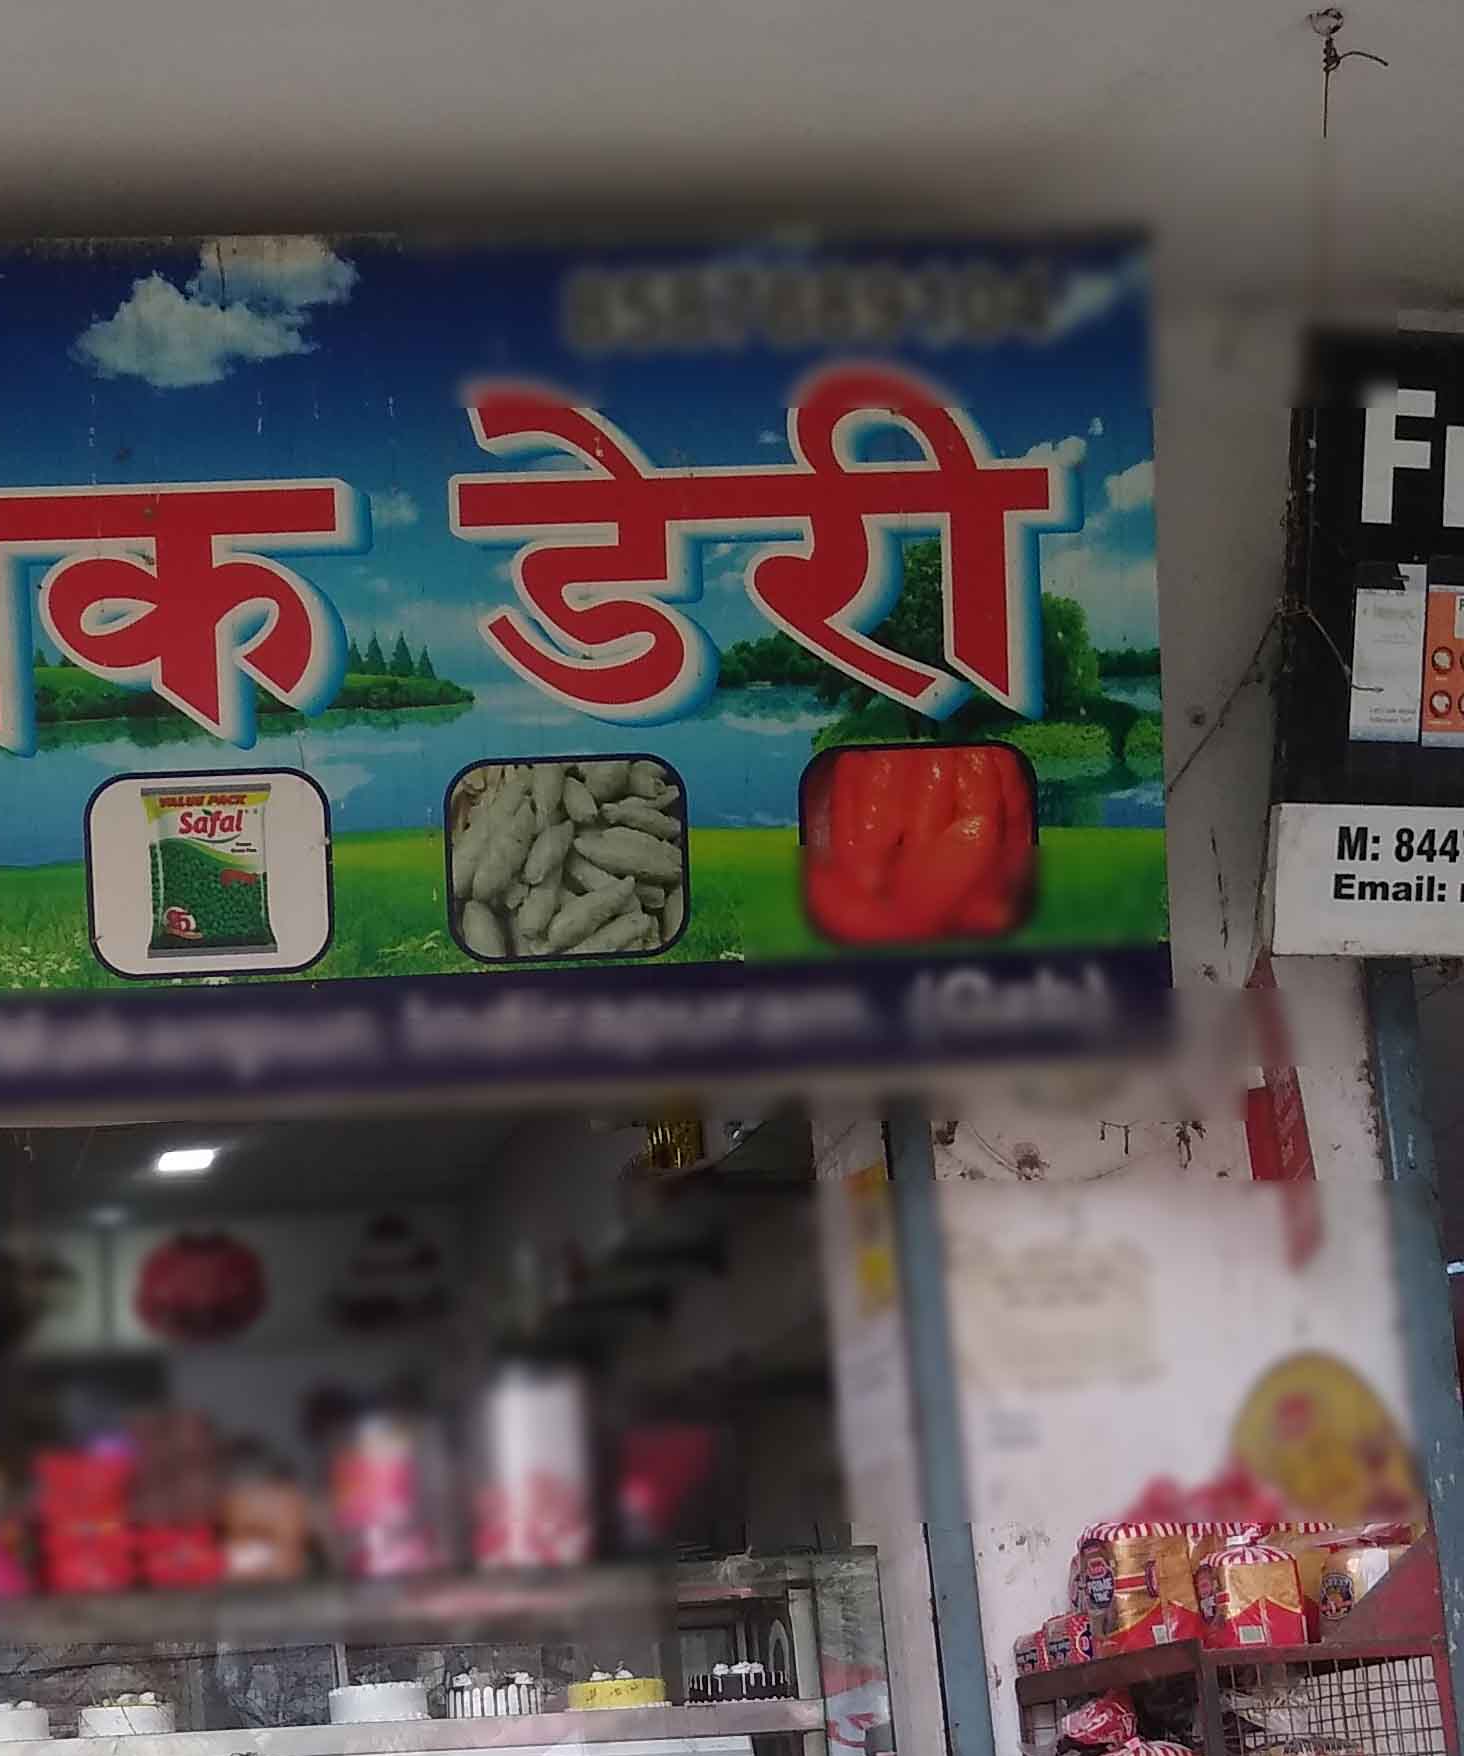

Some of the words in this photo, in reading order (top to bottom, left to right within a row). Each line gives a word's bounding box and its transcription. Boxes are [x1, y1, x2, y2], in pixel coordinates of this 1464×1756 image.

[449, 364, 1056, 724] डेरी
[179, 809, 243, 838] Safal
[1337, 826, 1380, 861] M:
[1394, 827, 1464, 863] 844
[1334, 874, 1446, 902] Email:
